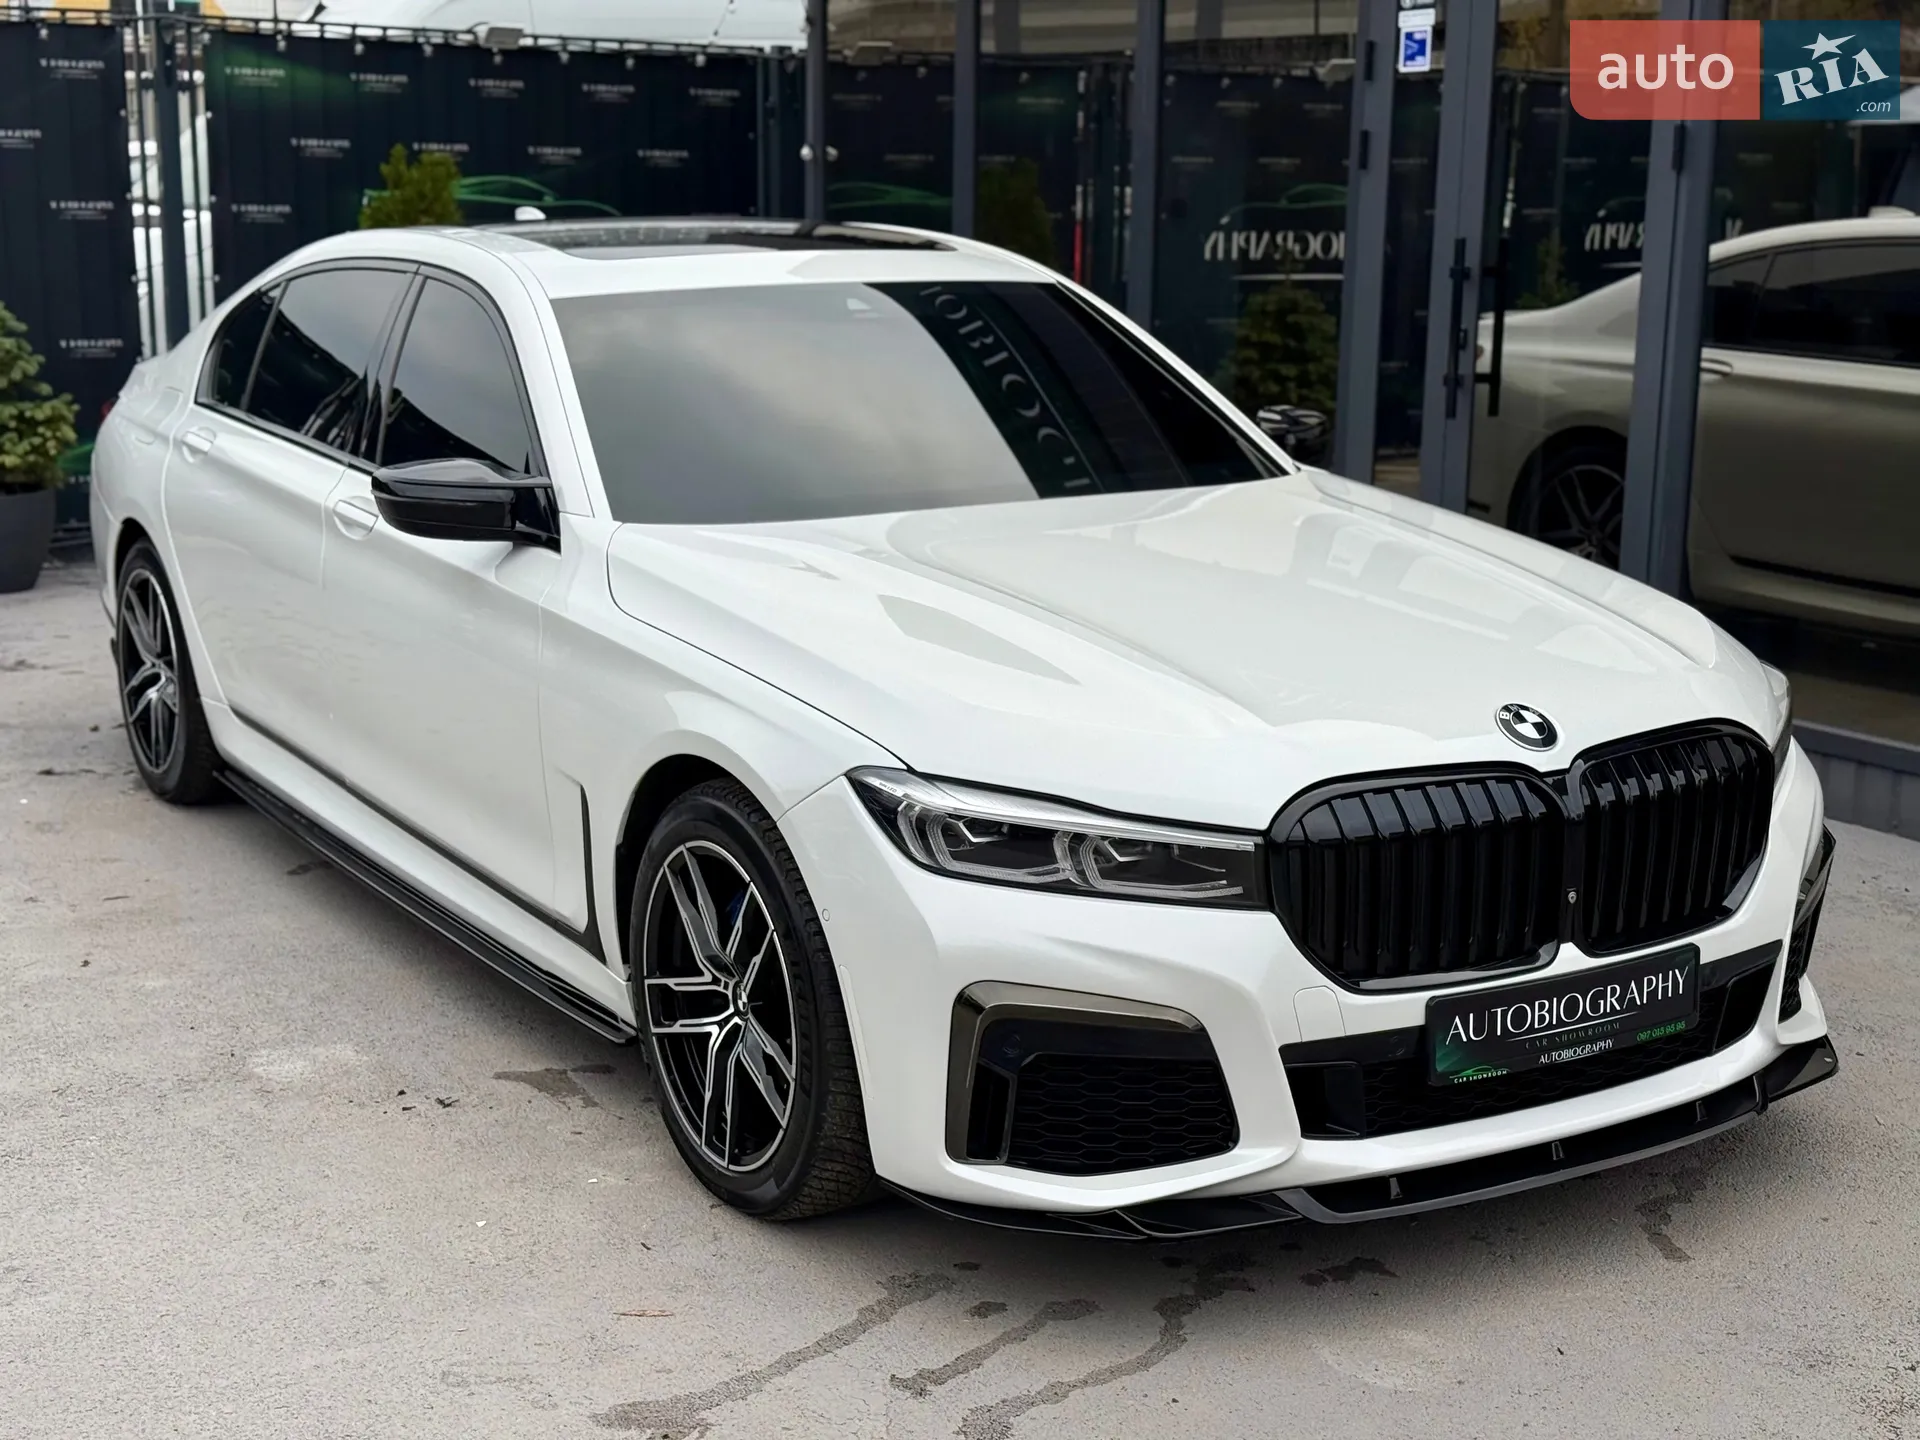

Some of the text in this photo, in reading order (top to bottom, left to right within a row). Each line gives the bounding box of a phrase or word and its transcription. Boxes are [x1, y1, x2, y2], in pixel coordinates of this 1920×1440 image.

[1445, 966, 1690, 1046] AUTOBIOGRAPHY
[1525, 1022, 1621, 1050] CAR SHOWROOM
[1538, 1038, 1615, 1065] AUTOBIOGRAPHY
[1469, 1070, 1508, 1082] SHOWROOM
